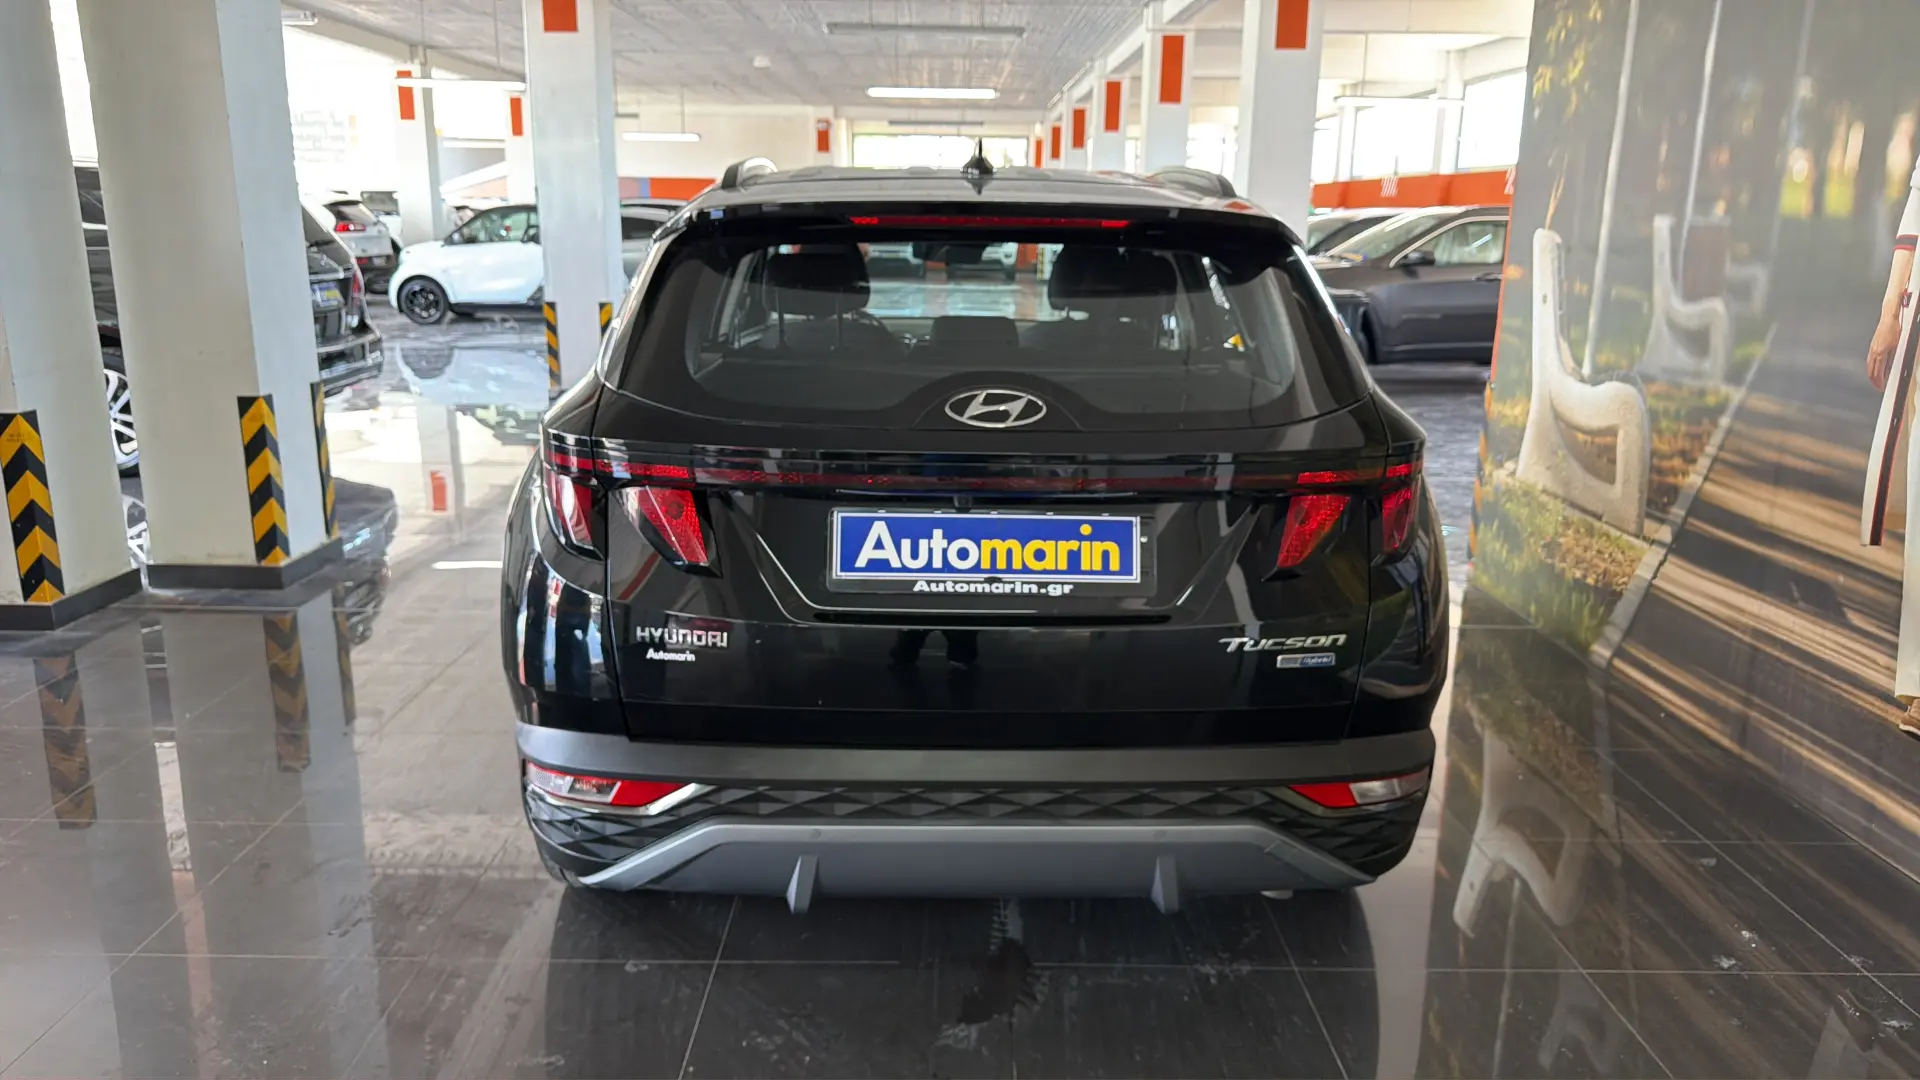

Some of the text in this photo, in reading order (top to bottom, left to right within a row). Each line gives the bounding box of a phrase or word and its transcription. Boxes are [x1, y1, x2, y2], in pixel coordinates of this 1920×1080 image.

[855, 521, 1120, 572] Automarin
[913, 580, 1073, 596] Automarin.gr
[636, 626, 728, 648] HYUNDAI
[646, 648, 695, 661] Automarin
